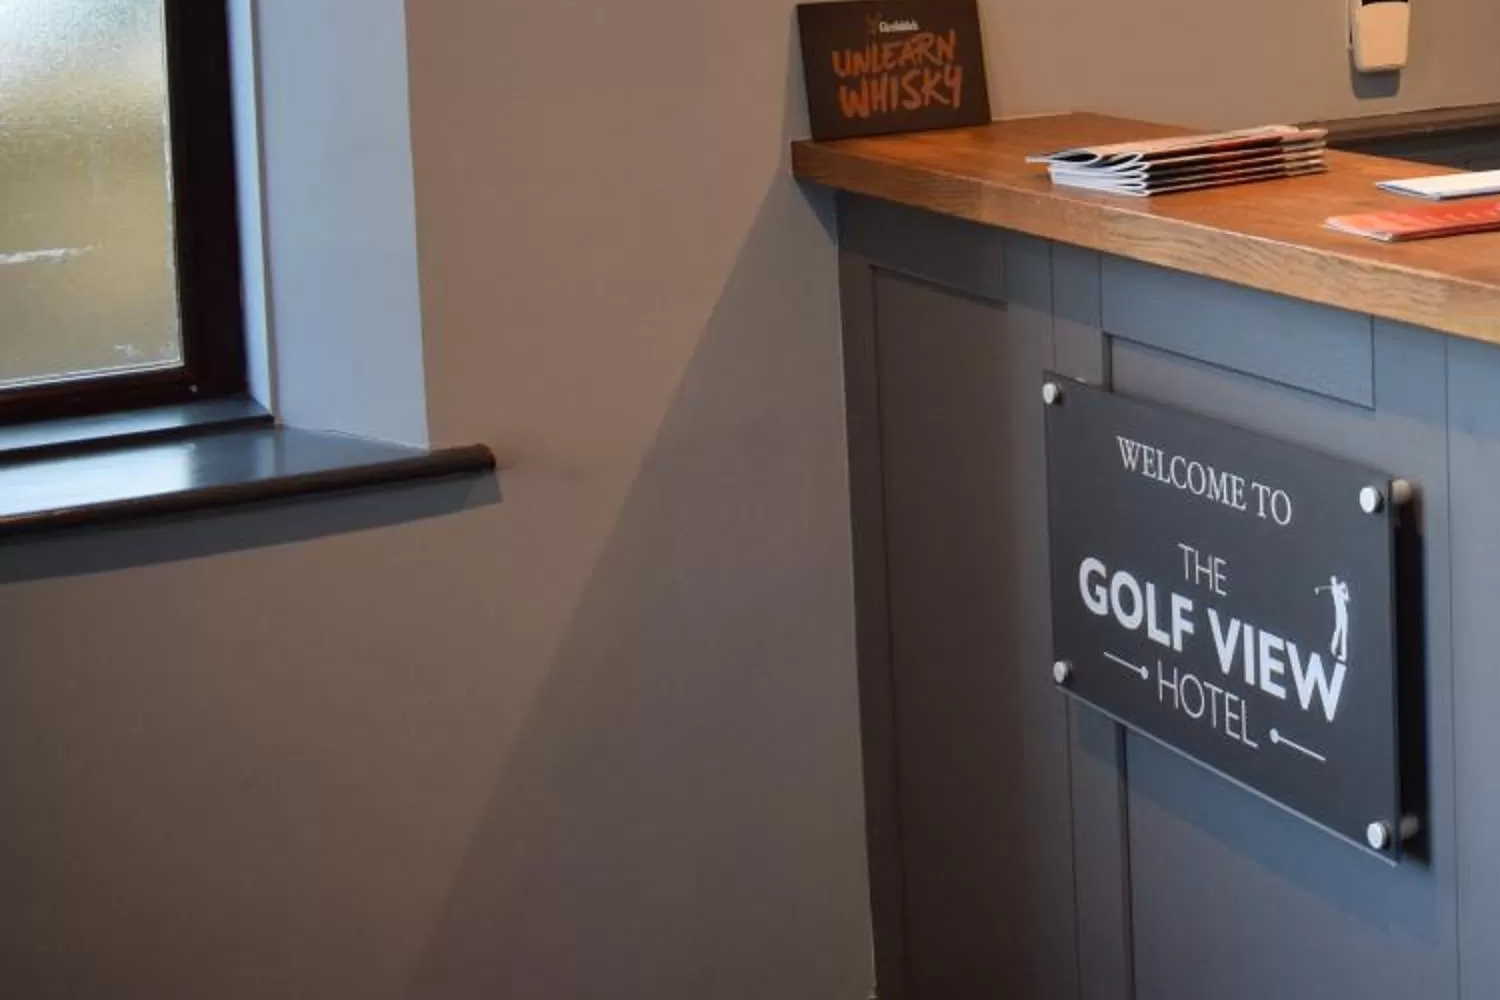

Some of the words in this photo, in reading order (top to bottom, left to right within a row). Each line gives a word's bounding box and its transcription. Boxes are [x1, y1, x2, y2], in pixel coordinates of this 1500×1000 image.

[831, 27, 957, 79] UNLEARN
[838, 64, 963, 119] WHISKY
[1115, 434, 1248, 512] WELCOME
[1251, 480, 1293, 527] TO
[1176, 542, 1228, 597] THE
[1078, 556, 1196, 653] GOLF
[1206, 607, 1348, 723] VIEW
[1156, 658, 1260, 750] HOTEL
